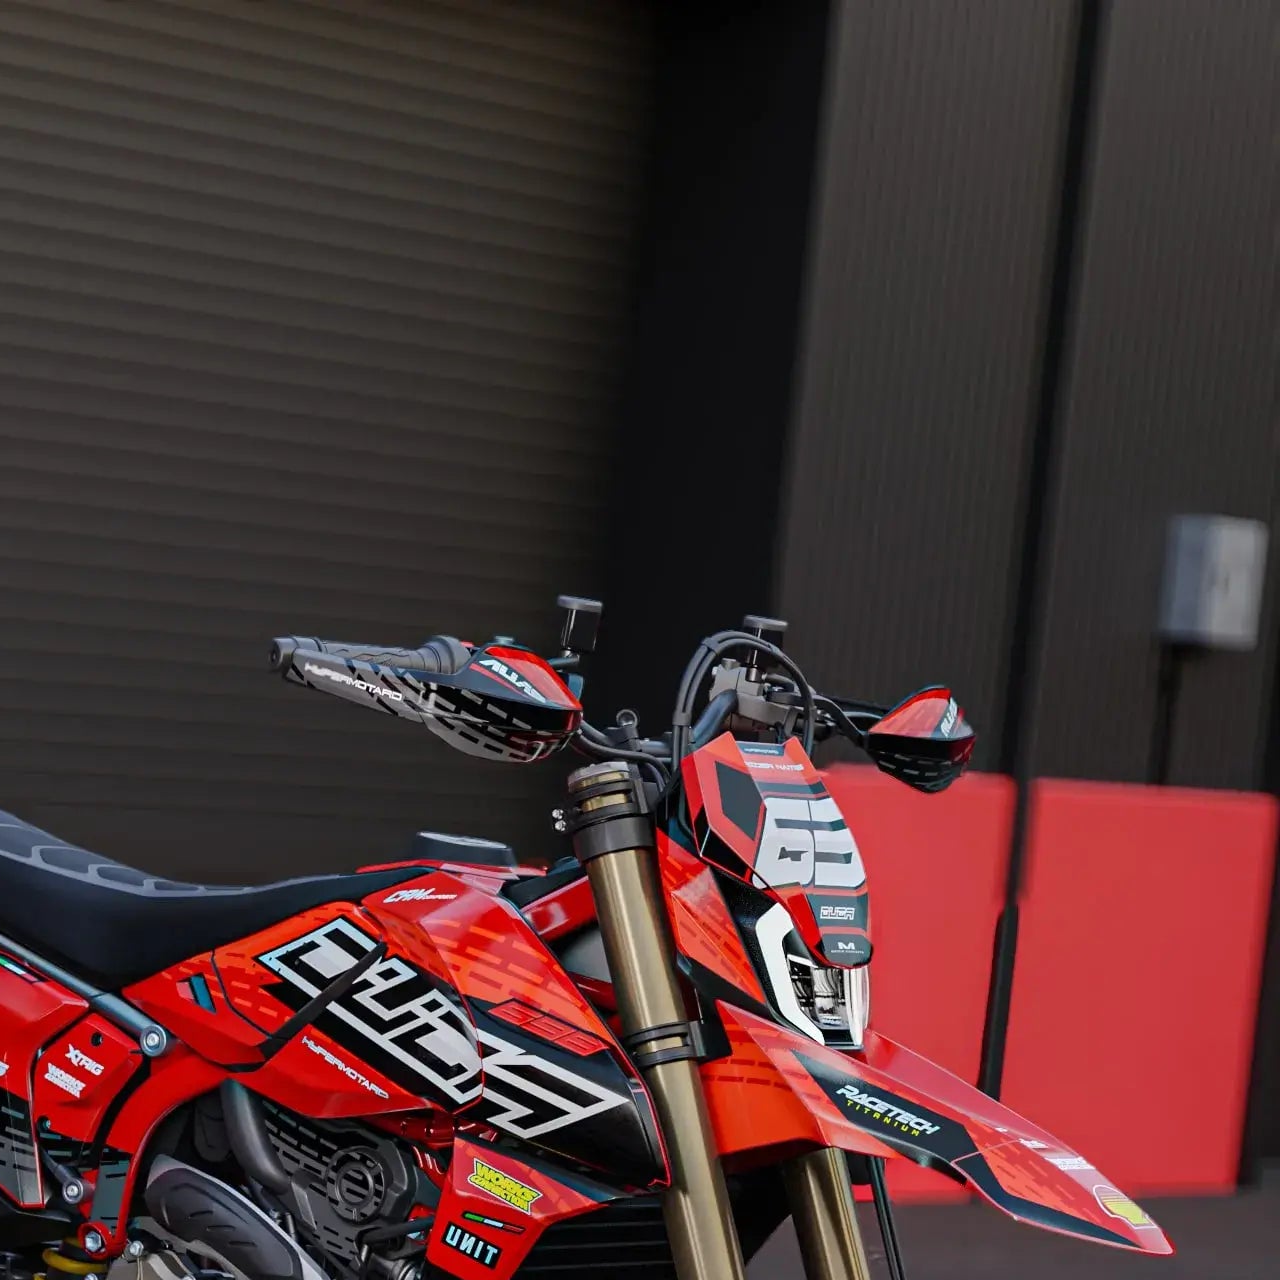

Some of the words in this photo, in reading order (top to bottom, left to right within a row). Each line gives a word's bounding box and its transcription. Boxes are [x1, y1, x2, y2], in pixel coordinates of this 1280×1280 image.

[304, 662, 403, 701] HYPERMOTARD
[65, 1043, 105, 1075] XTRIG
[302, 1036, 390, 1099] HYPERMOTARD
[836, 1085, 940, 1135] RACETECH
[848, 1100, 921, 1137] TITANIUM
